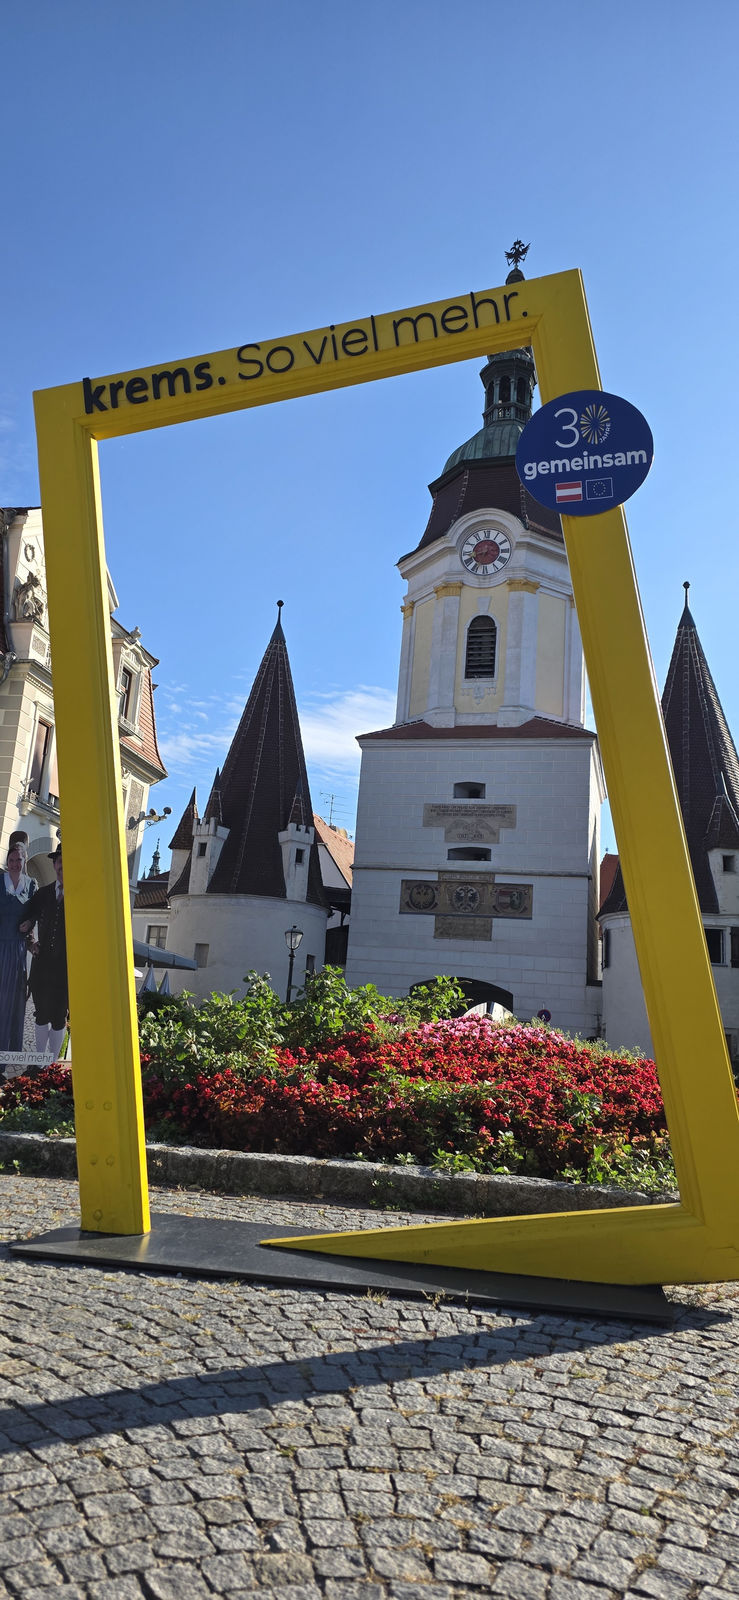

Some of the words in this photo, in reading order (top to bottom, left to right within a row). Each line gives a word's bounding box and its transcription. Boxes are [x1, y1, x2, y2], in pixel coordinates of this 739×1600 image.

[82, 362, 226, 414] krems.
[236, 343, 295, 380] So
[303, 315, 379, 365] viel
[393, 291, 529, 346] mehr.
[599, 422, 612, 444] JAHRE
[523, 449, 647, 481] gemeinsam
[11, 1052, 27, 1062] viel
[28, 1053, 53, 1063] mehr.
